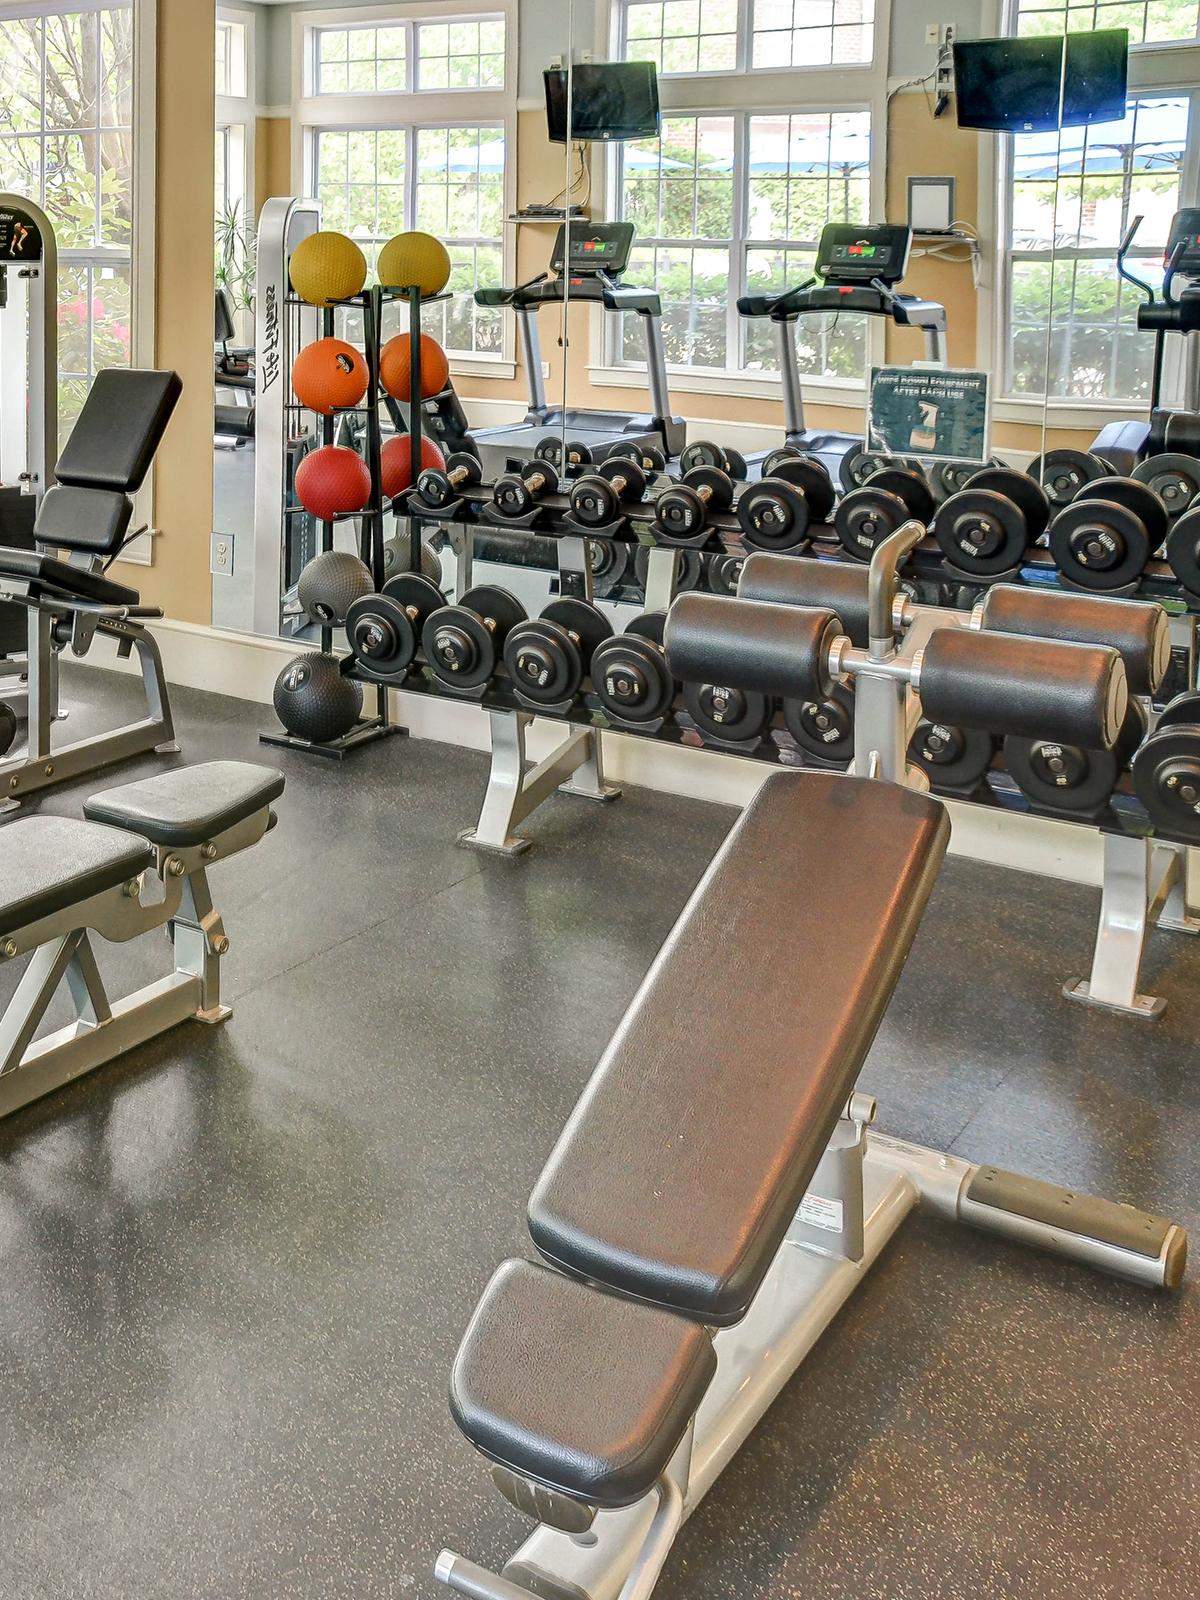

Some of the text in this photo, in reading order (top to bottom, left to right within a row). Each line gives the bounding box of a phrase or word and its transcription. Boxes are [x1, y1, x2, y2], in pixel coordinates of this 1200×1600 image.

[901, 375, 929, 385] DOWN
[930, 376, 980, 390] EQUIPMENT
[893, 386, 920, 397] AFTER
[947, 389, 964, 400] USE
